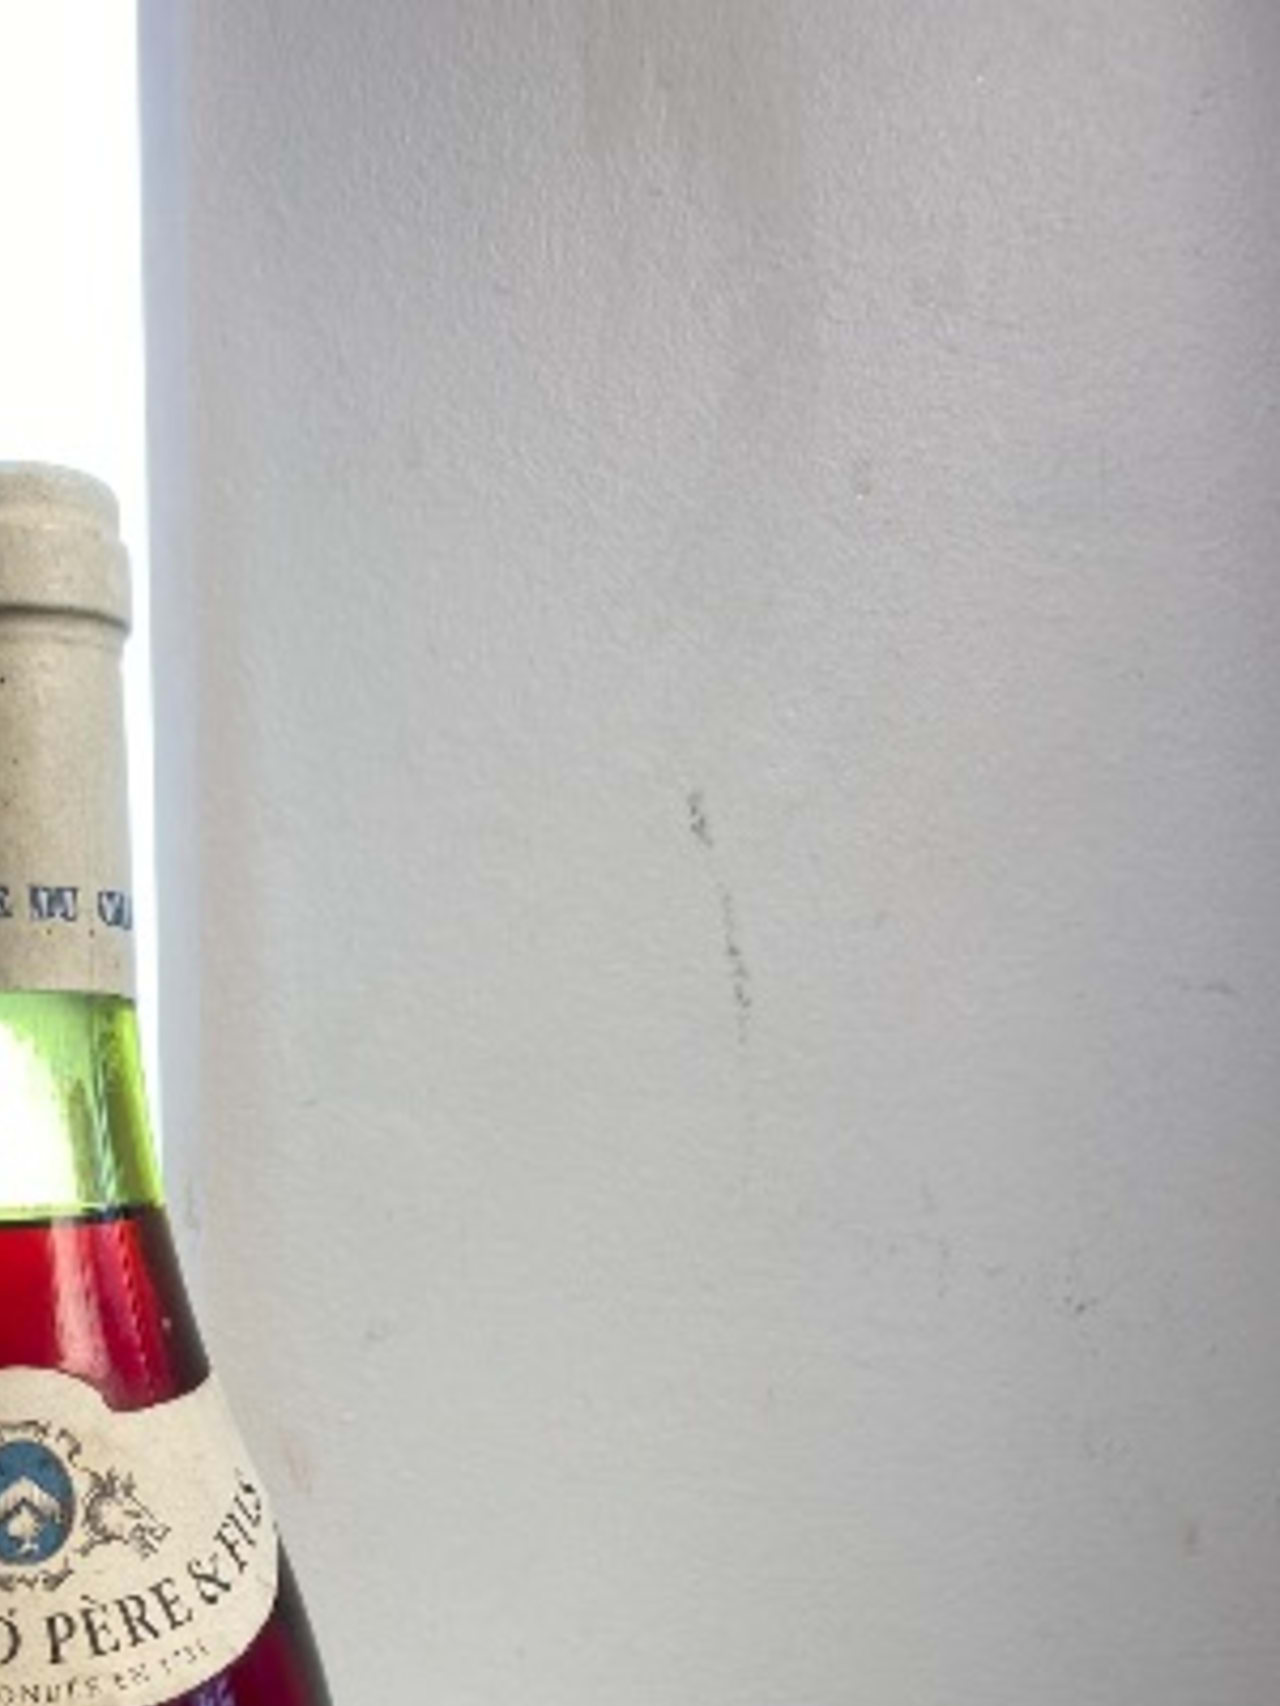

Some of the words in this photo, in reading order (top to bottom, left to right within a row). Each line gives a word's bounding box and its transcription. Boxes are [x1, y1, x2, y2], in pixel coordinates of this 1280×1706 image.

[48, 1593, 194, 1667] PÈRE
[187, 1552, 231, 1605] &
[213, 1466, 262, 1575] FILS
